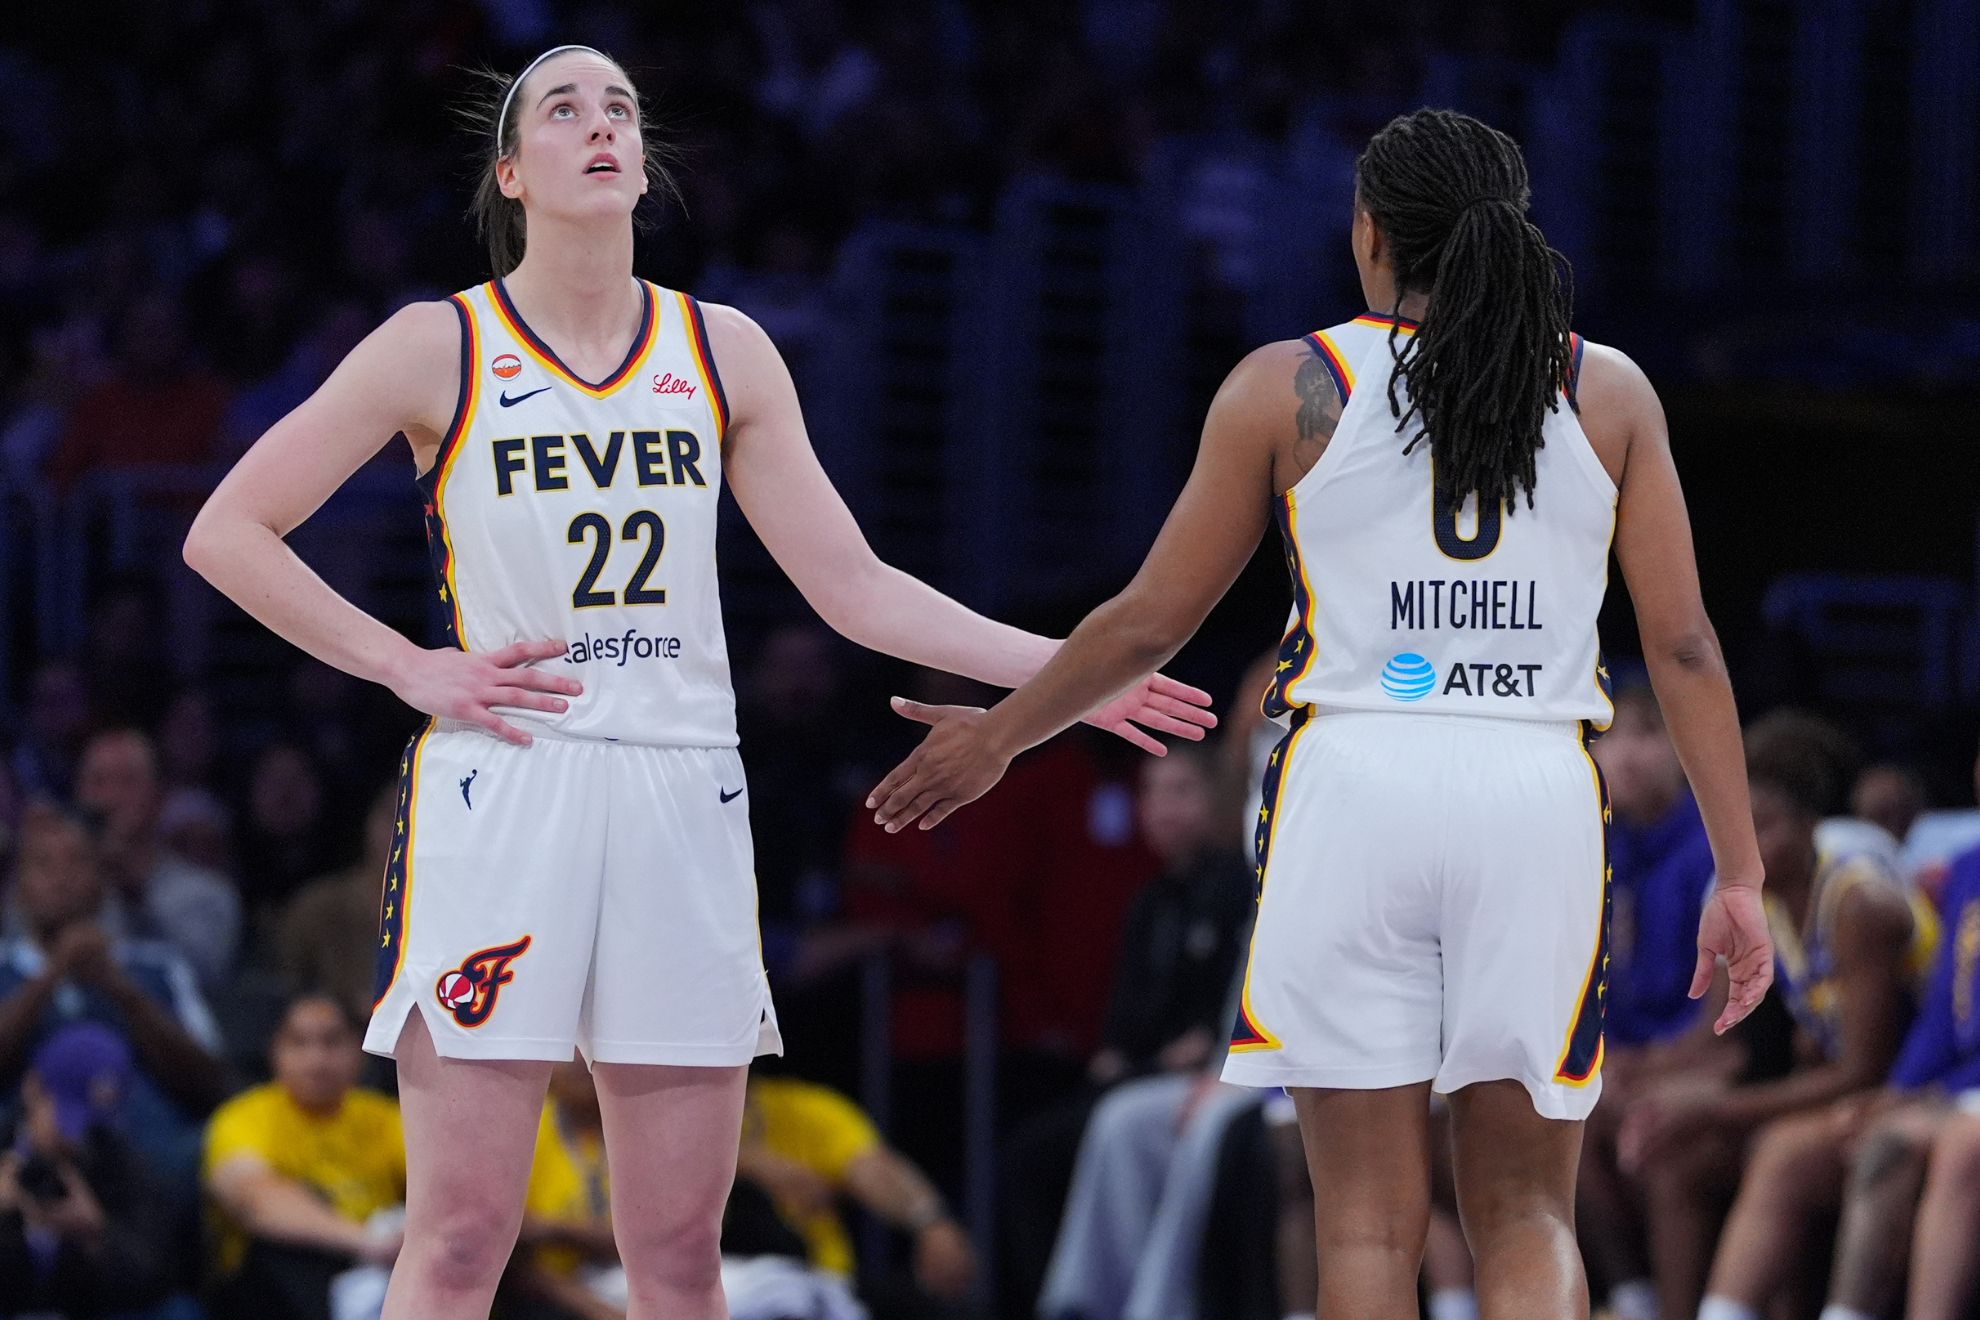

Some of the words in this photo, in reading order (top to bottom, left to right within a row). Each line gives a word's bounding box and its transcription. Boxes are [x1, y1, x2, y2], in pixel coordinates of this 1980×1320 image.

[652, 372, 697, 400] Lilly
[491, 429, 708, 498] FEVER
[566, 508, 668, 611] 22
[1391, 580, 1543, 631] MITCHELL
[564, 628, 681, 667] alesforce
[1442, 662, 1543, 698] AT&T
